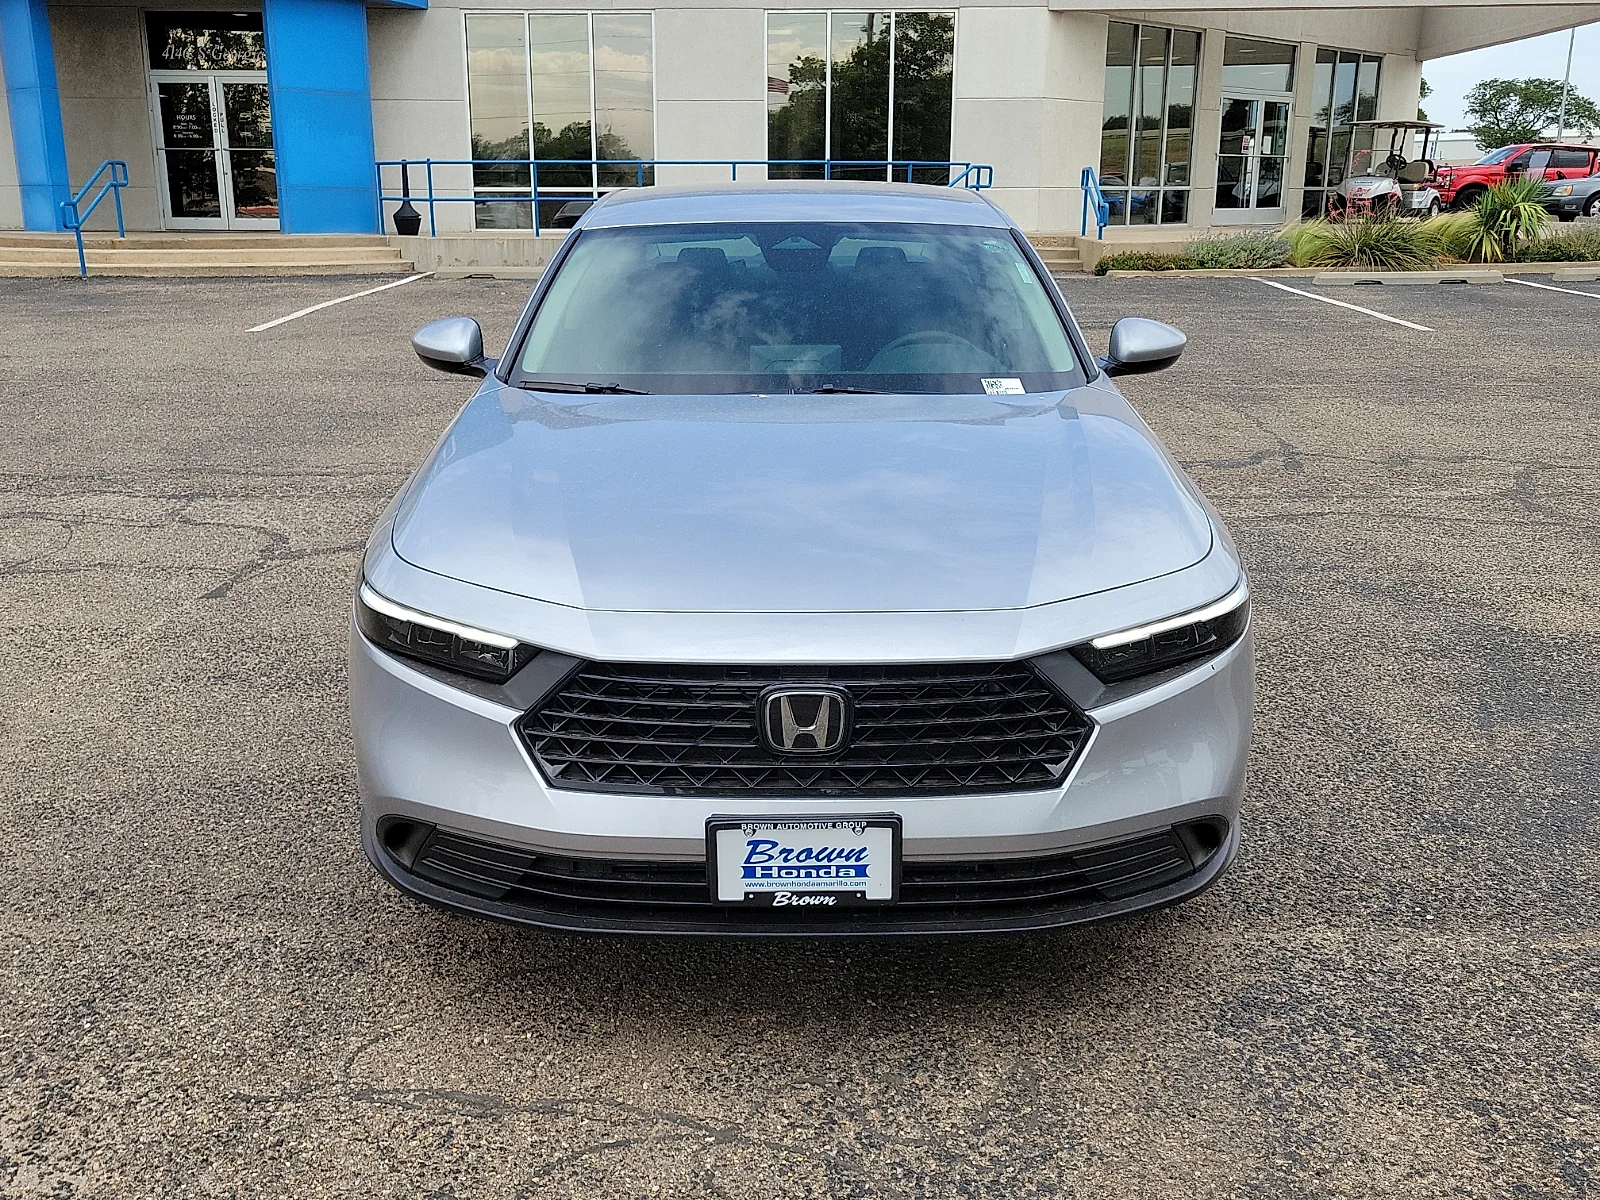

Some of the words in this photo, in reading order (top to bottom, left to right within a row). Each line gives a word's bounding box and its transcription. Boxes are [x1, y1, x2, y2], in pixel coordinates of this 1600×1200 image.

[211, 102, 219, 134] LOCKED
[741, 822, 774, 830] BROWN
[776, 822, 833, 830] AUTOMOTIVE
[835, 821, 867, 829] GROUP
[743, 839, 870, 865] Brown
[755, 866, 856, 878] Honda
[744, 880, 867, 888] www.brownhondaamarillo.com
[772, 891, 838, 906] Brown
